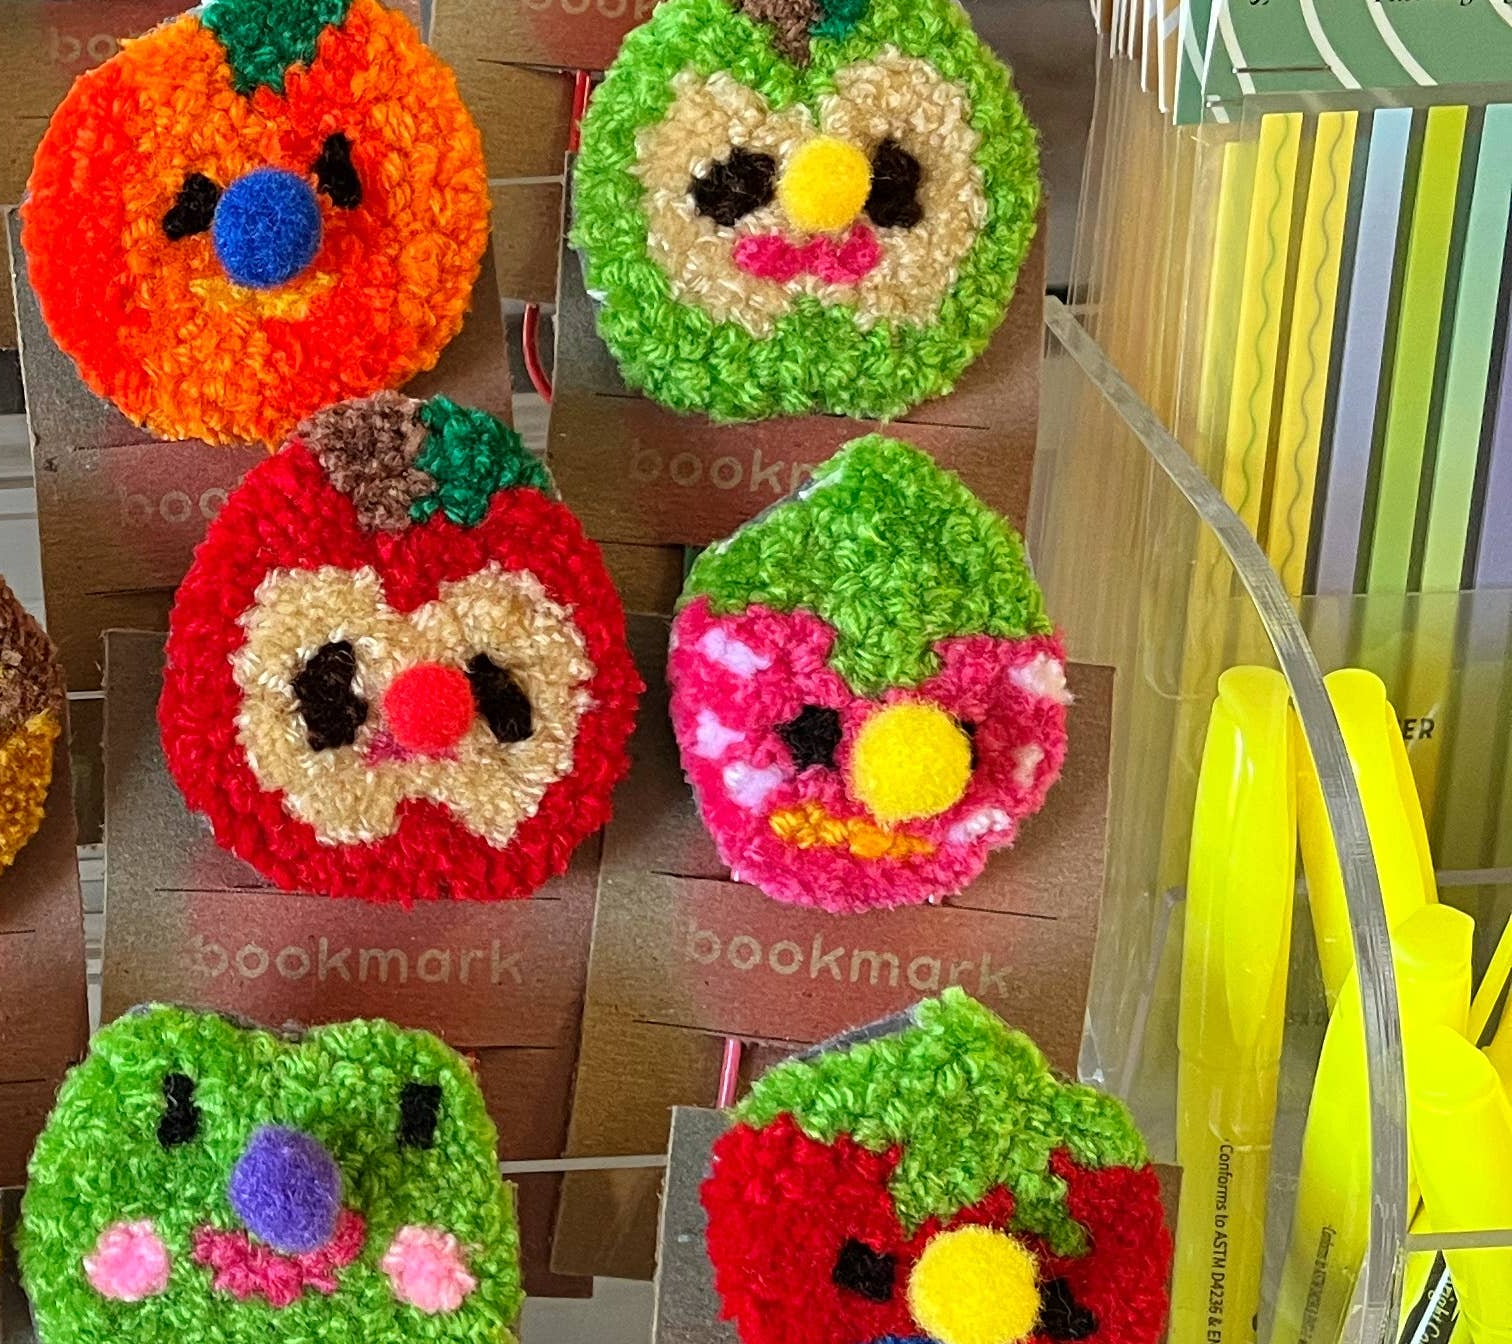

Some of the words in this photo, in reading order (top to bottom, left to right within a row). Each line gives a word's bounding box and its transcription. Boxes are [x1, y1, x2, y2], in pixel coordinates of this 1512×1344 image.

[630, 447, 818, 495] book
[1402, 718, 1435, 740] ER
[189, 934, 526, 987] bookmark
[686, 921, 1013, 1000] bookmark
[1216, 1144, 1234, 1210] Conforms
[1215, 1215, 1229, 1228] to
[1211, 1230, 1228, 1268] ASTM
[1209, 1272, 1225, 1314] D4236
[1427, 1275, 1455, 1323] right
[1208, 1316, 1223, 1327] &
